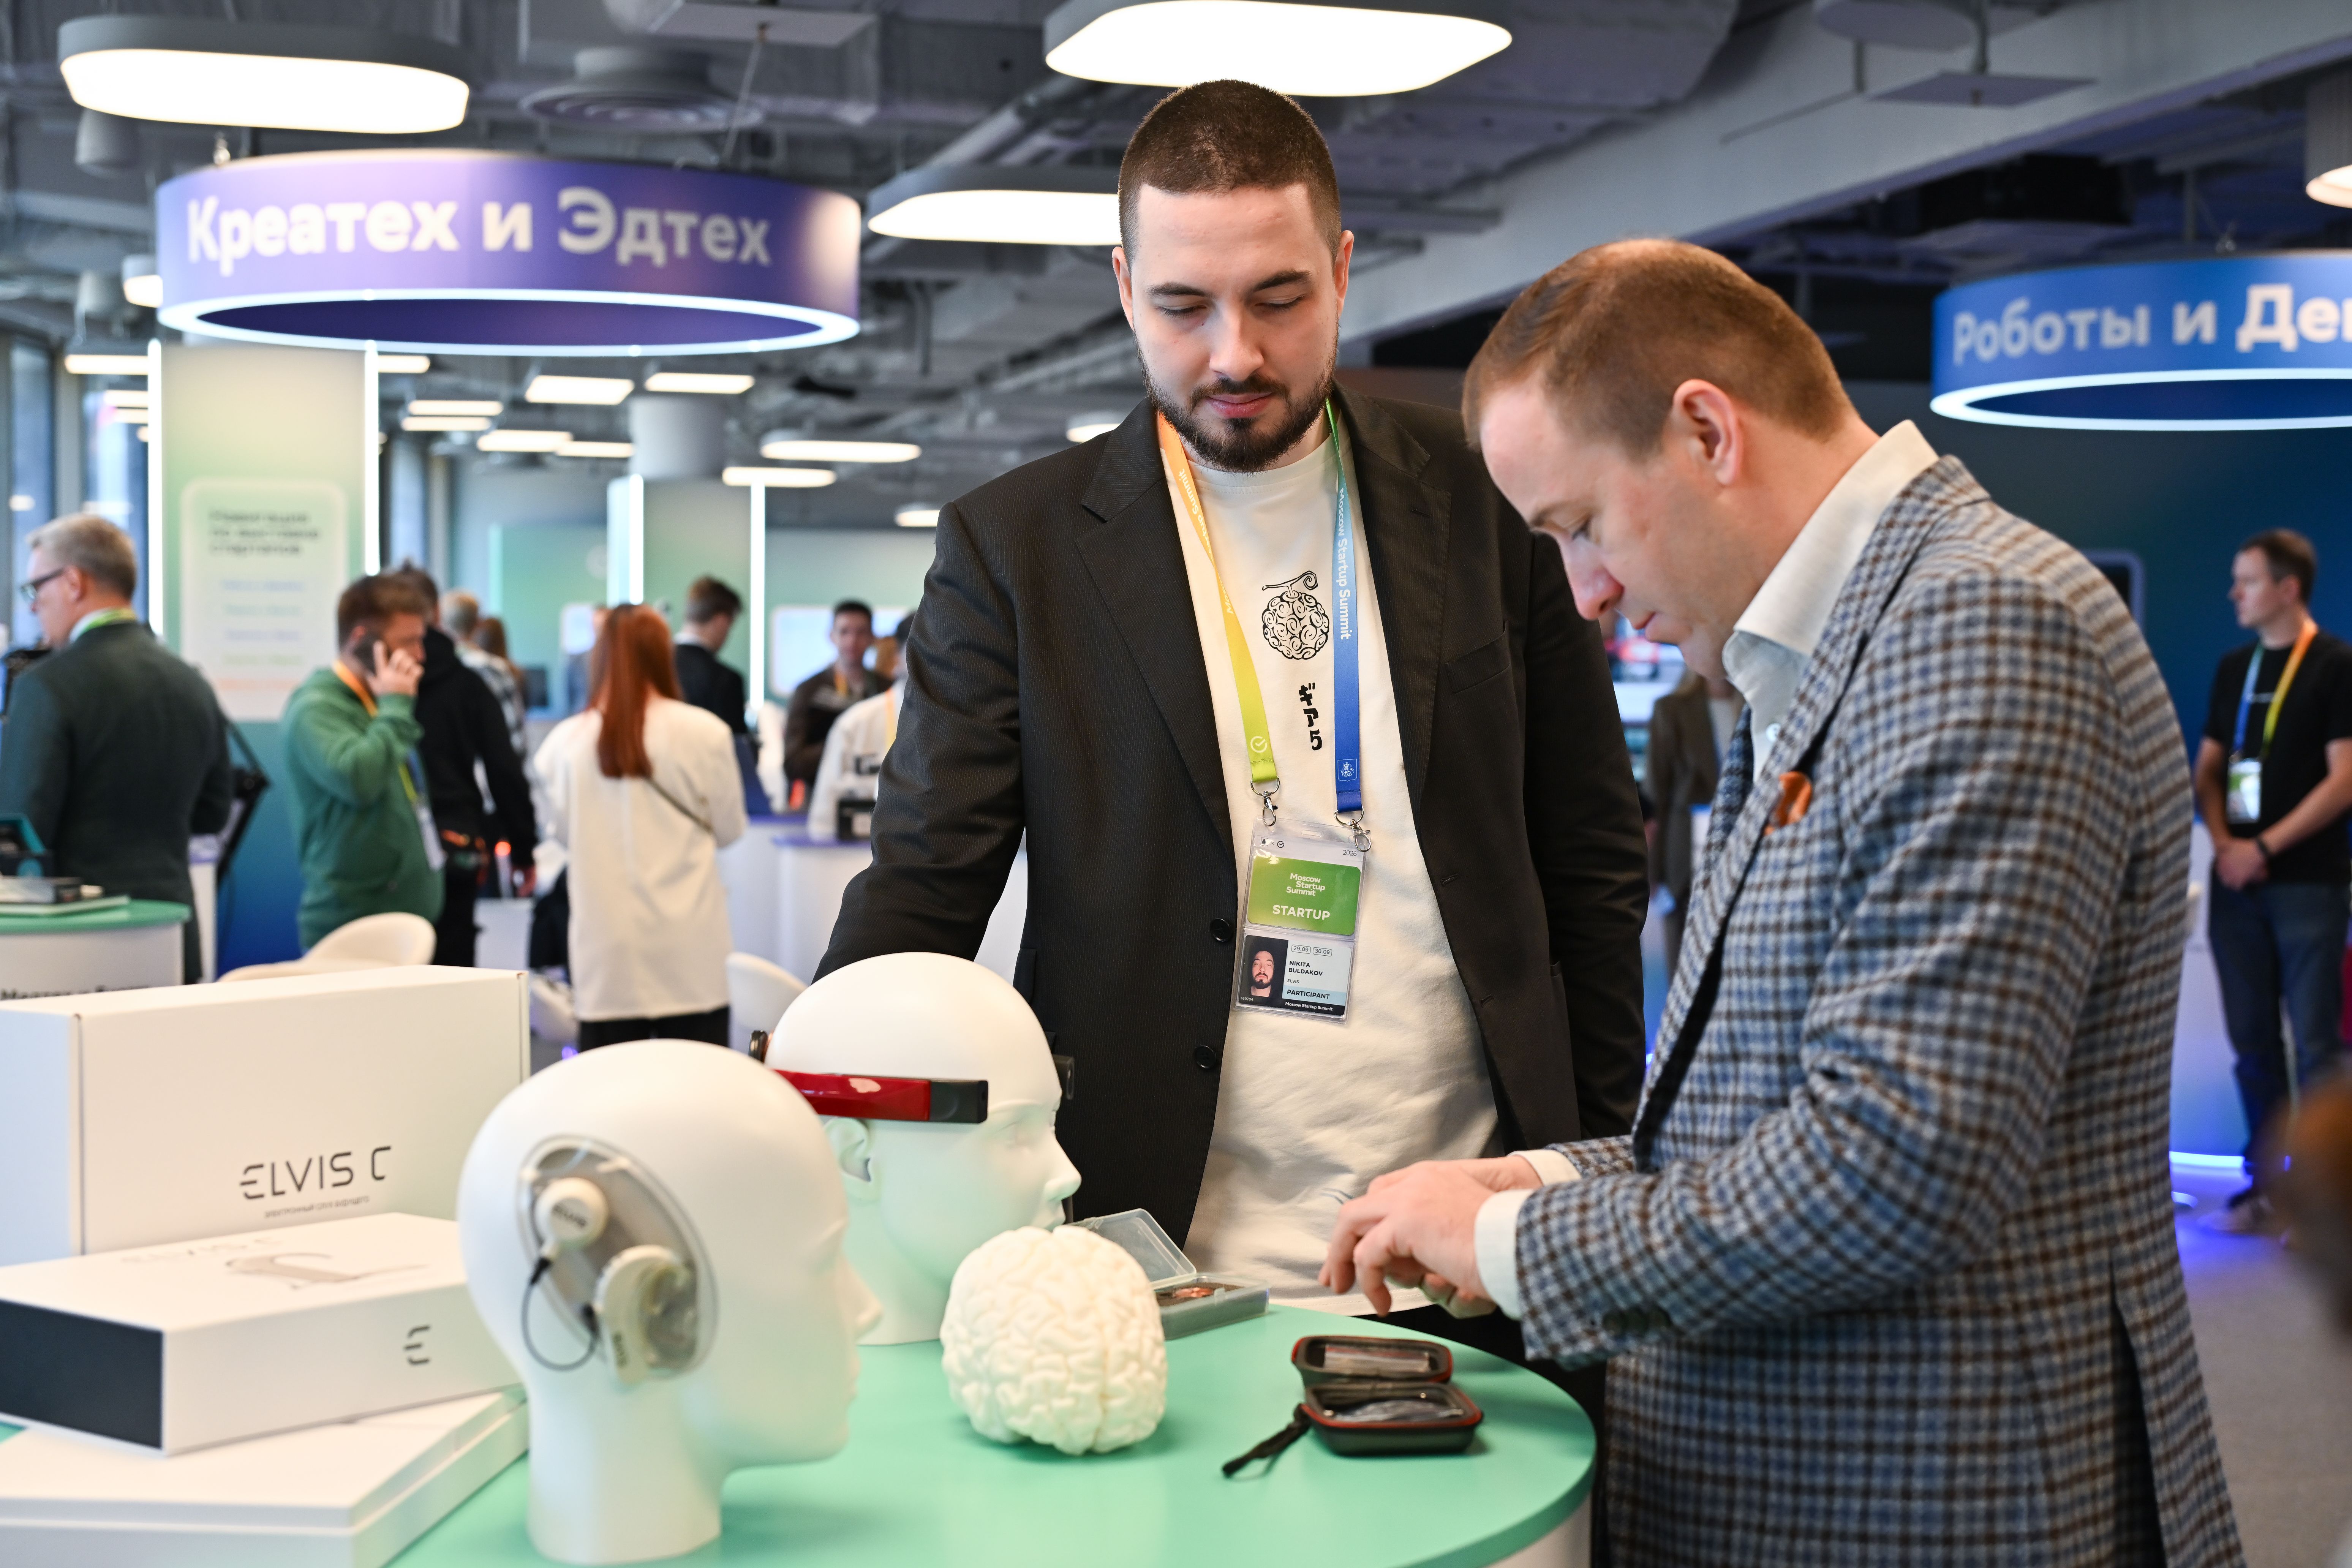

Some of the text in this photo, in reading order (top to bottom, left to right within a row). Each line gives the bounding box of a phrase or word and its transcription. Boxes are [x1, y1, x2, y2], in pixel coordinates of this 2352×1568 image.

[188, 185, 772, 277] Креатех и Эдтех
[1952, 297, 2151, 366] Роботы
[2172, 300, 2218, 345] и
[1178, 468, 1199, 515] Summit
[1336, 538, 1348, 587] Startup
[1339, 590, 1353, 640] Summit
[1298, 682, 1323, 751] ギア5
[1286, 886, 1316, 896] Summit
[1290, 873, 1321, 883] Moscow
[1296, 880, 1325, 892] Startup
[1272, 904, 1331, 920] STARTUP
[1287, 989, 1331, 999] PARTICIPANT
[1288, 967, 1323, 976] BULDAKOV
[239, 1145, 392, 1200] ELVIS C
